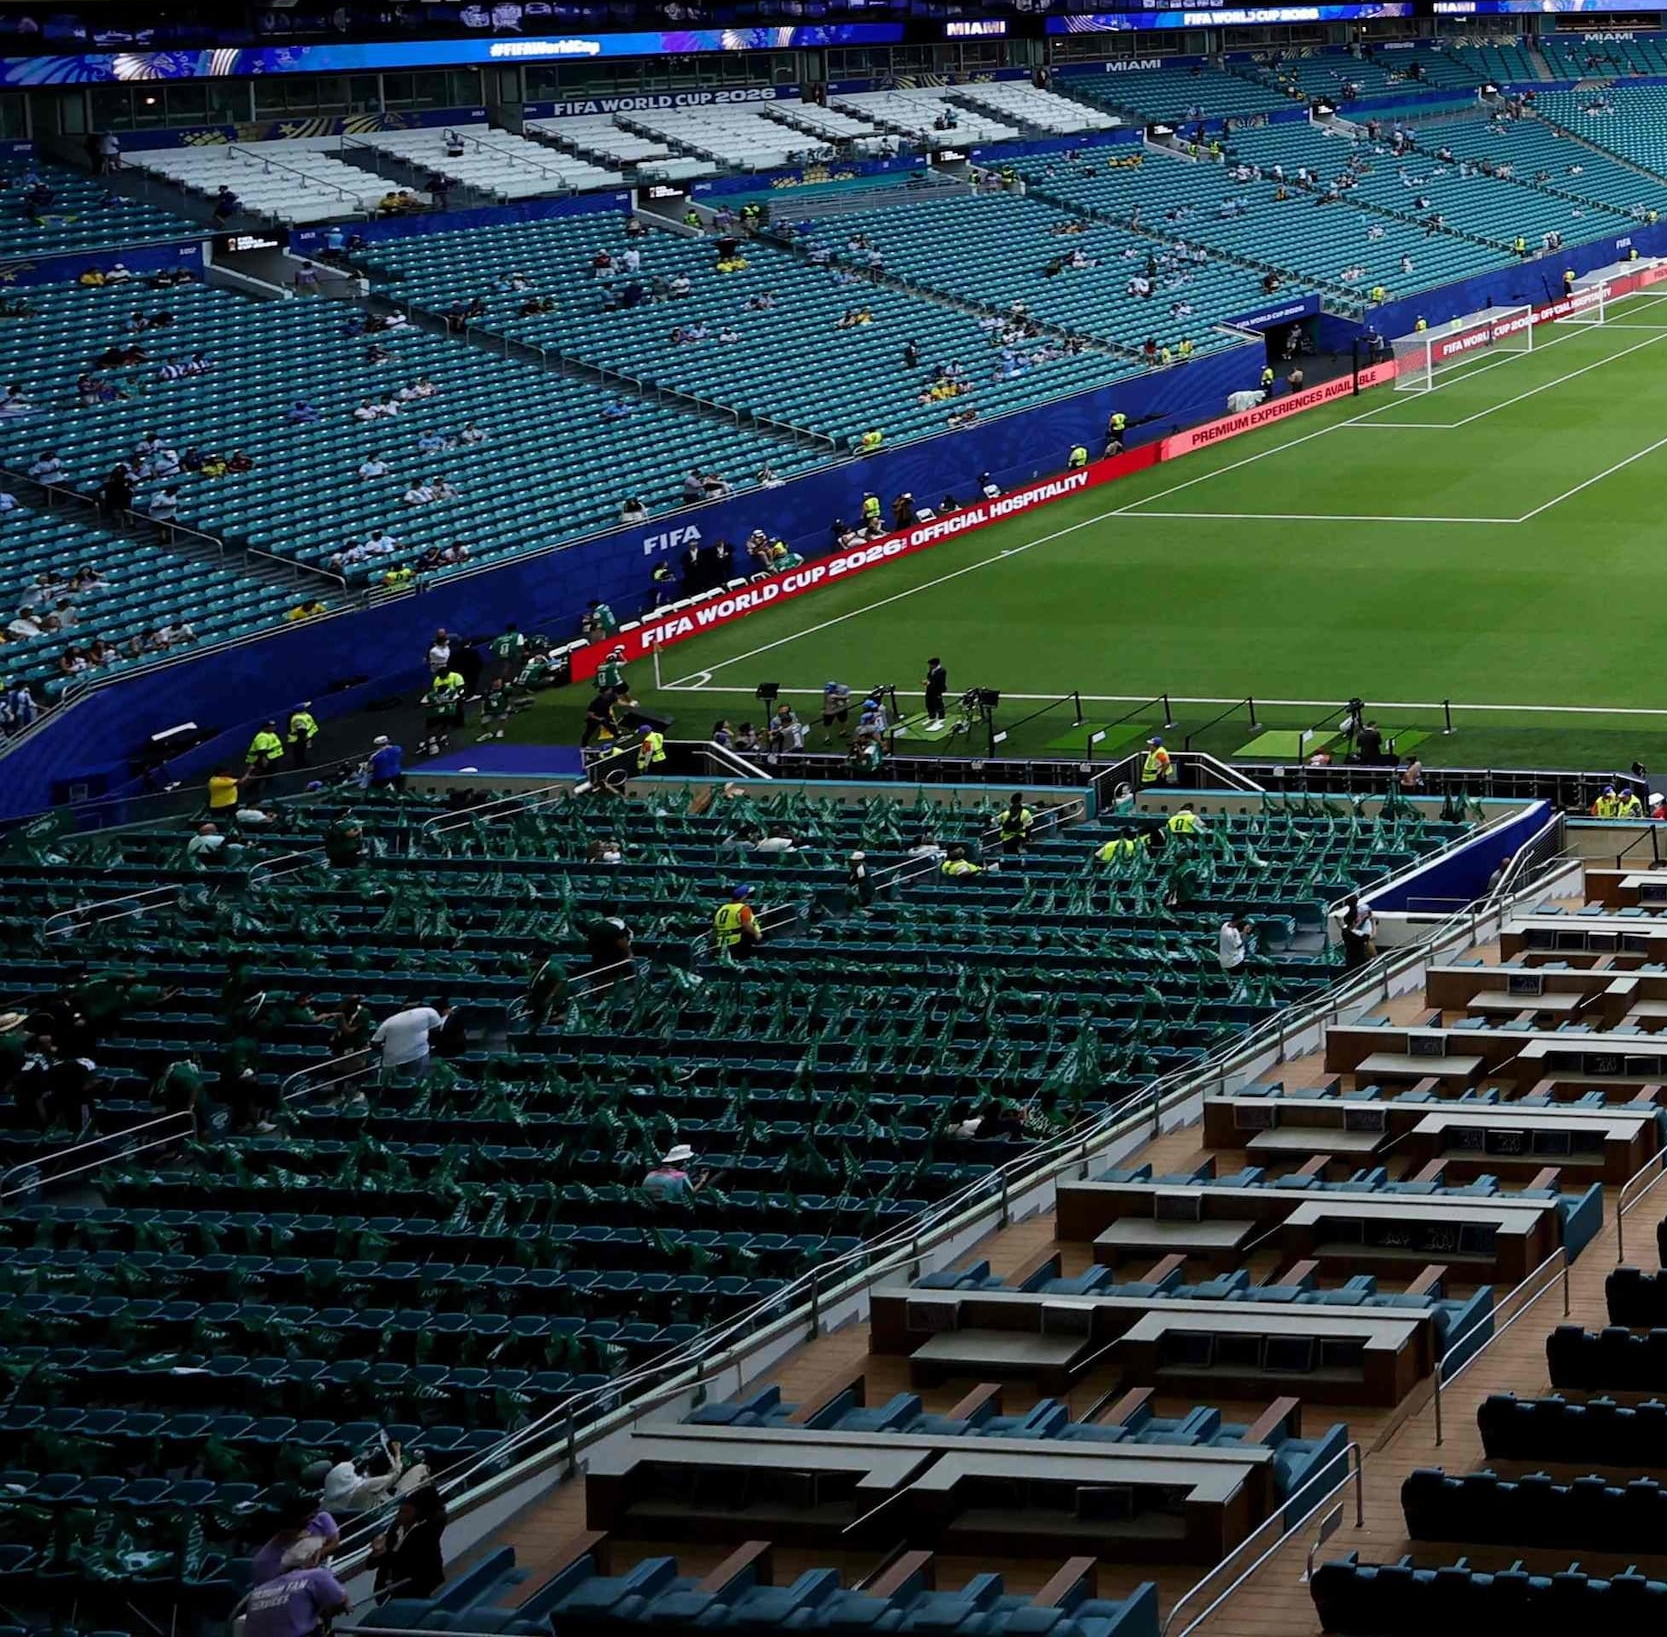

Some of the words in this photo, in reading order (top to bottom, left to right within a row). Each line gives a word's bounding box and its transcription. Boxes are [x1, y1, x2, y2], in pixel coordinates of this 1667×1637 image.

[946, 21, 1006, 36] MIAMI
[1584, 33, 1634, 42] MIAMI
[1106, 58, 1162, 72] MIAMI
[554, 101, 598, 116] FIFA
[600, 96, 672, 111] WORLD
[675, 93, 712, 106] CUP
[715, 88, 777, 103] 2026
[1442, 339, 1464, 356] FIFA
[1464, 330, 1490, 349] WORL
[1192, 416, 1249, 445] PREMIUM
[1250, 385, 1323, 424] EXPERIENCES
[1324, 371, 1377, 403] AVAILBLE
[644, 525, 702, 556] FIFA
[641, 618, 694, 649] FIFA
[696, 583, 780, 629] WORLD
[781, 565, 827, 594] CUP
[910, 507, 989, 547] OFFICIAL
[990, 470, 1089, 519] HOSPITALITY
